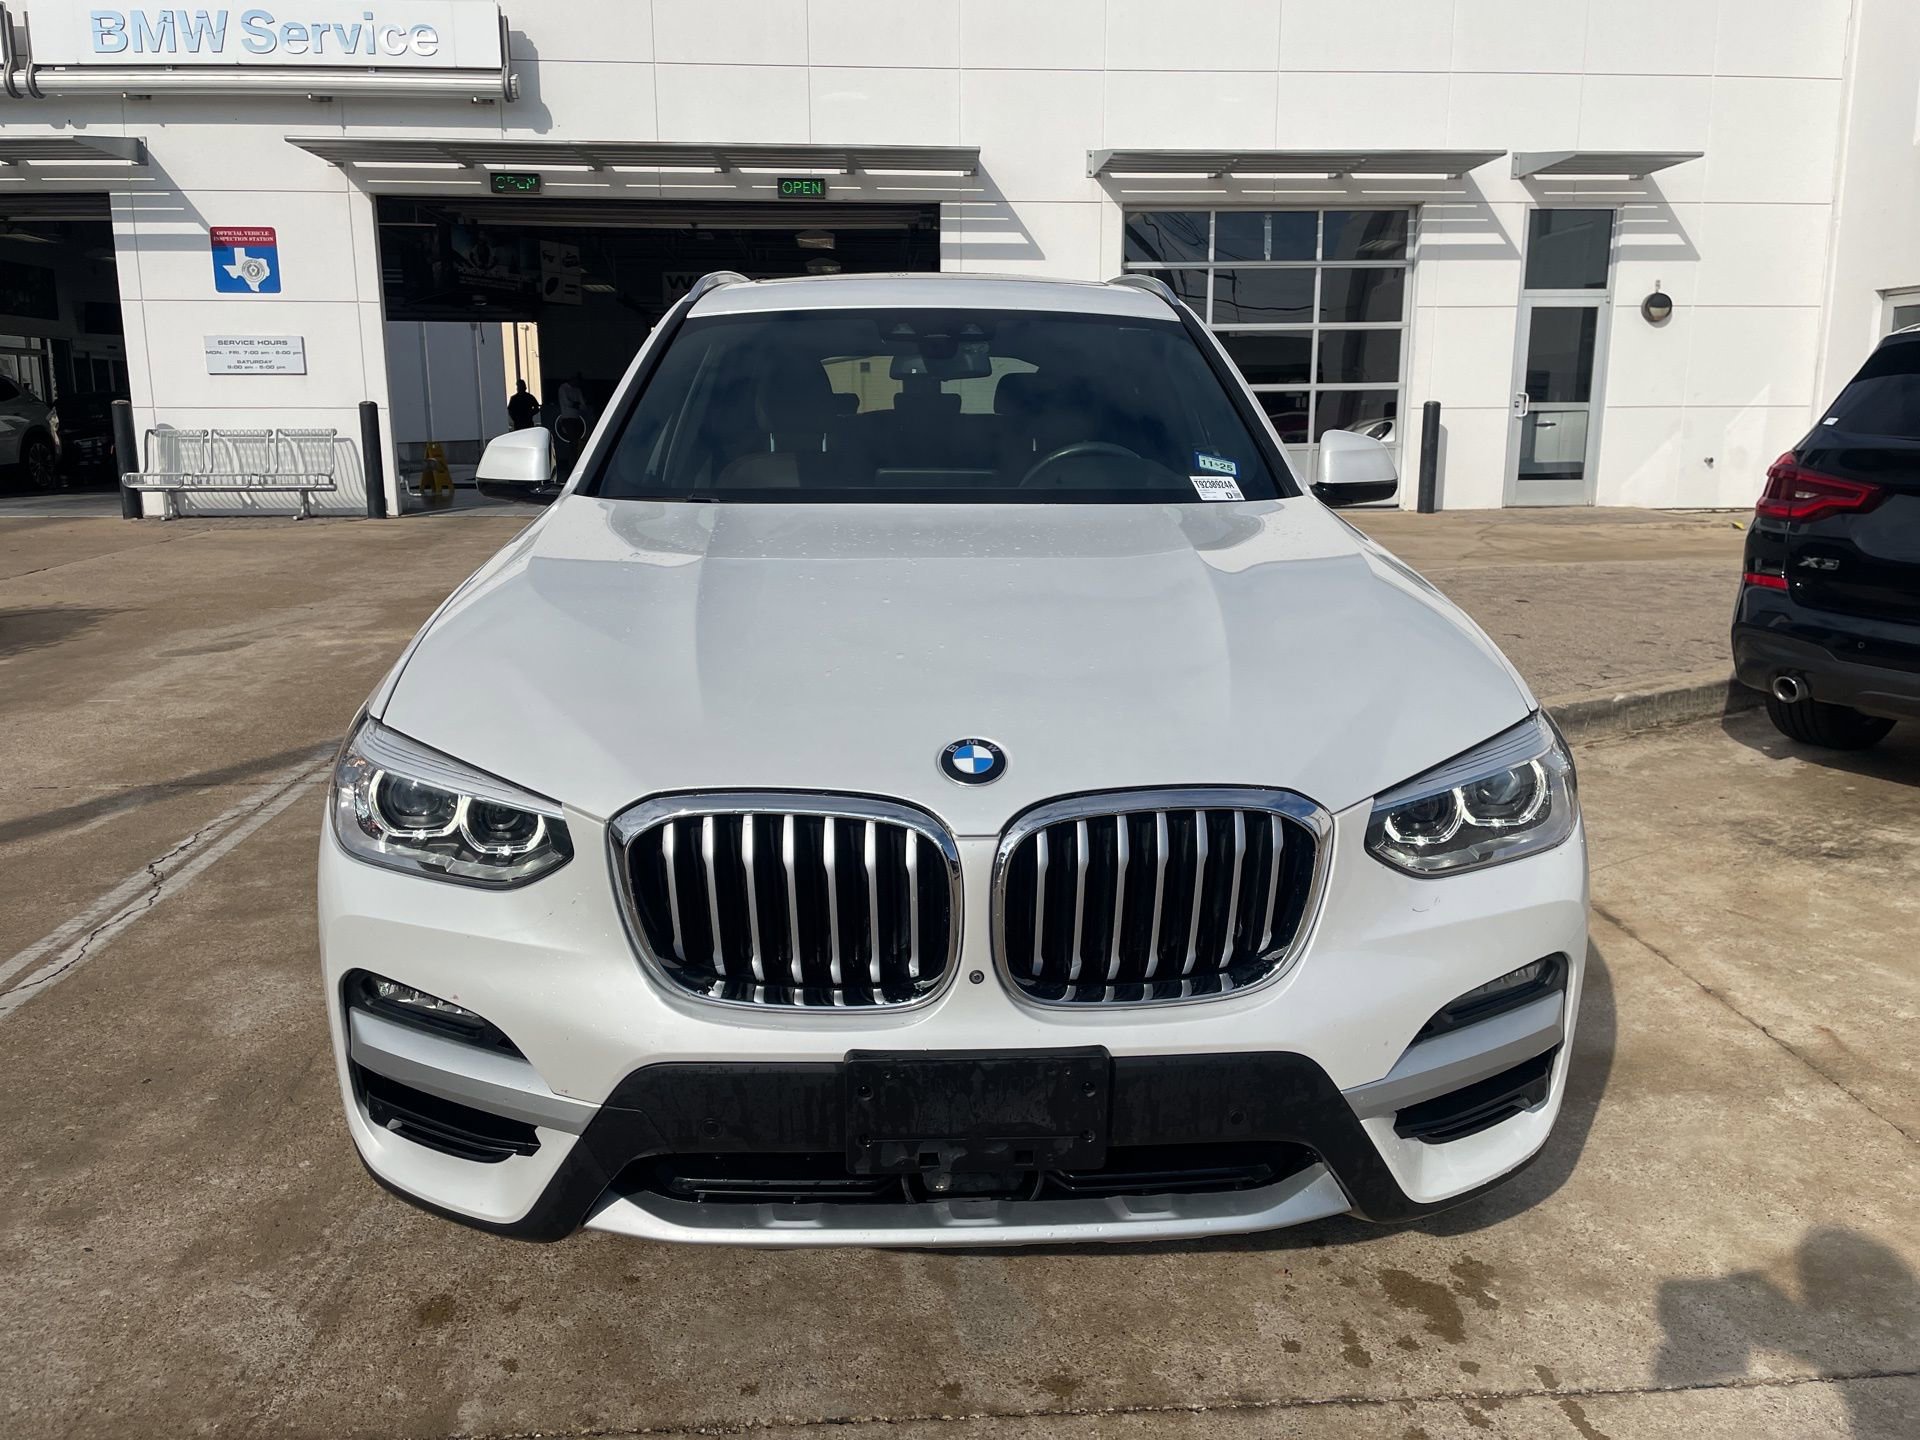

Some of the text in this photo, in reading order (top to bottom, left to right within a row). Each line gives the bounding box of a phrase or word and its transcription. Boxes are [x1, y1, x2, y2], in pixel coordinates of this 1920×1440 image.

[90, 8, 439, 56] BMW Service
[782, 181, 821, 194] OPEN
[1797, 556, 1840, 571] X3
